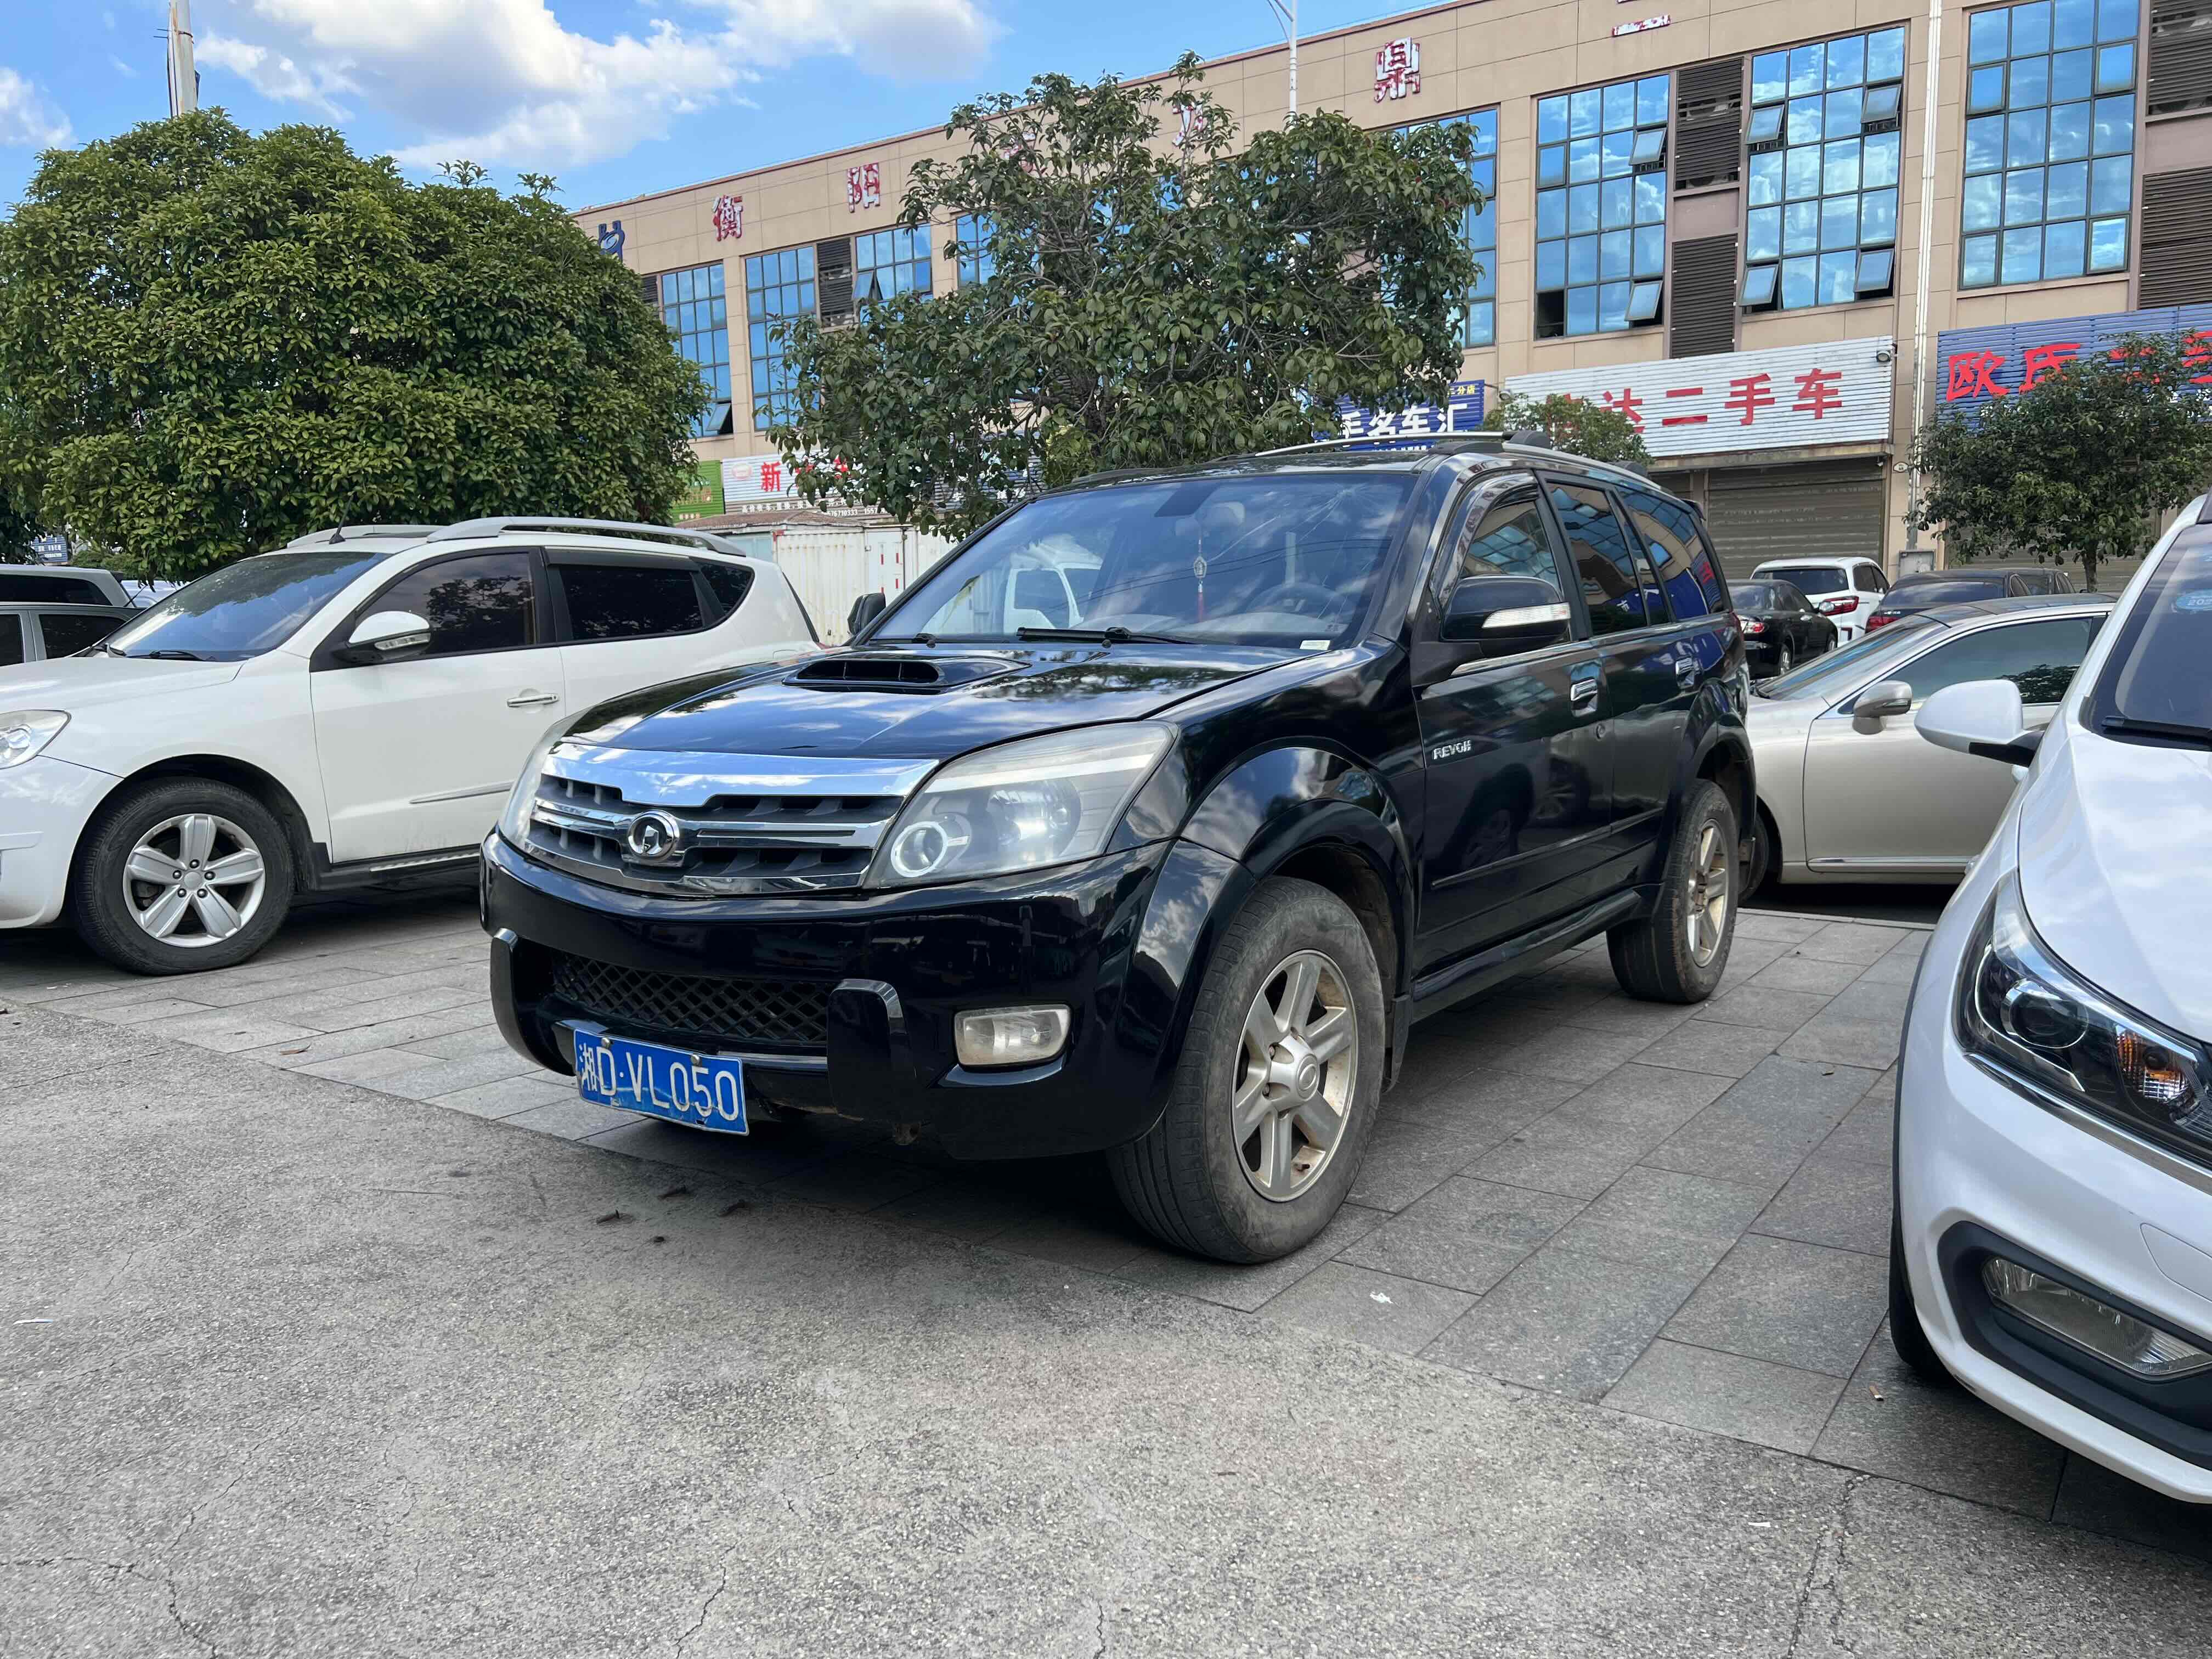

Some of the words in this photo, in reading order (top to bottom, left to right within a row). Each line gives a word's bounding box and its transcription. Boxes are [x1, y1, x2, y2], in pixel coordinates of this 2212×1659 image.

[1315, 404, 1468, 441] 手名车汇
[1434, 740, 1471, 760] REVOH
